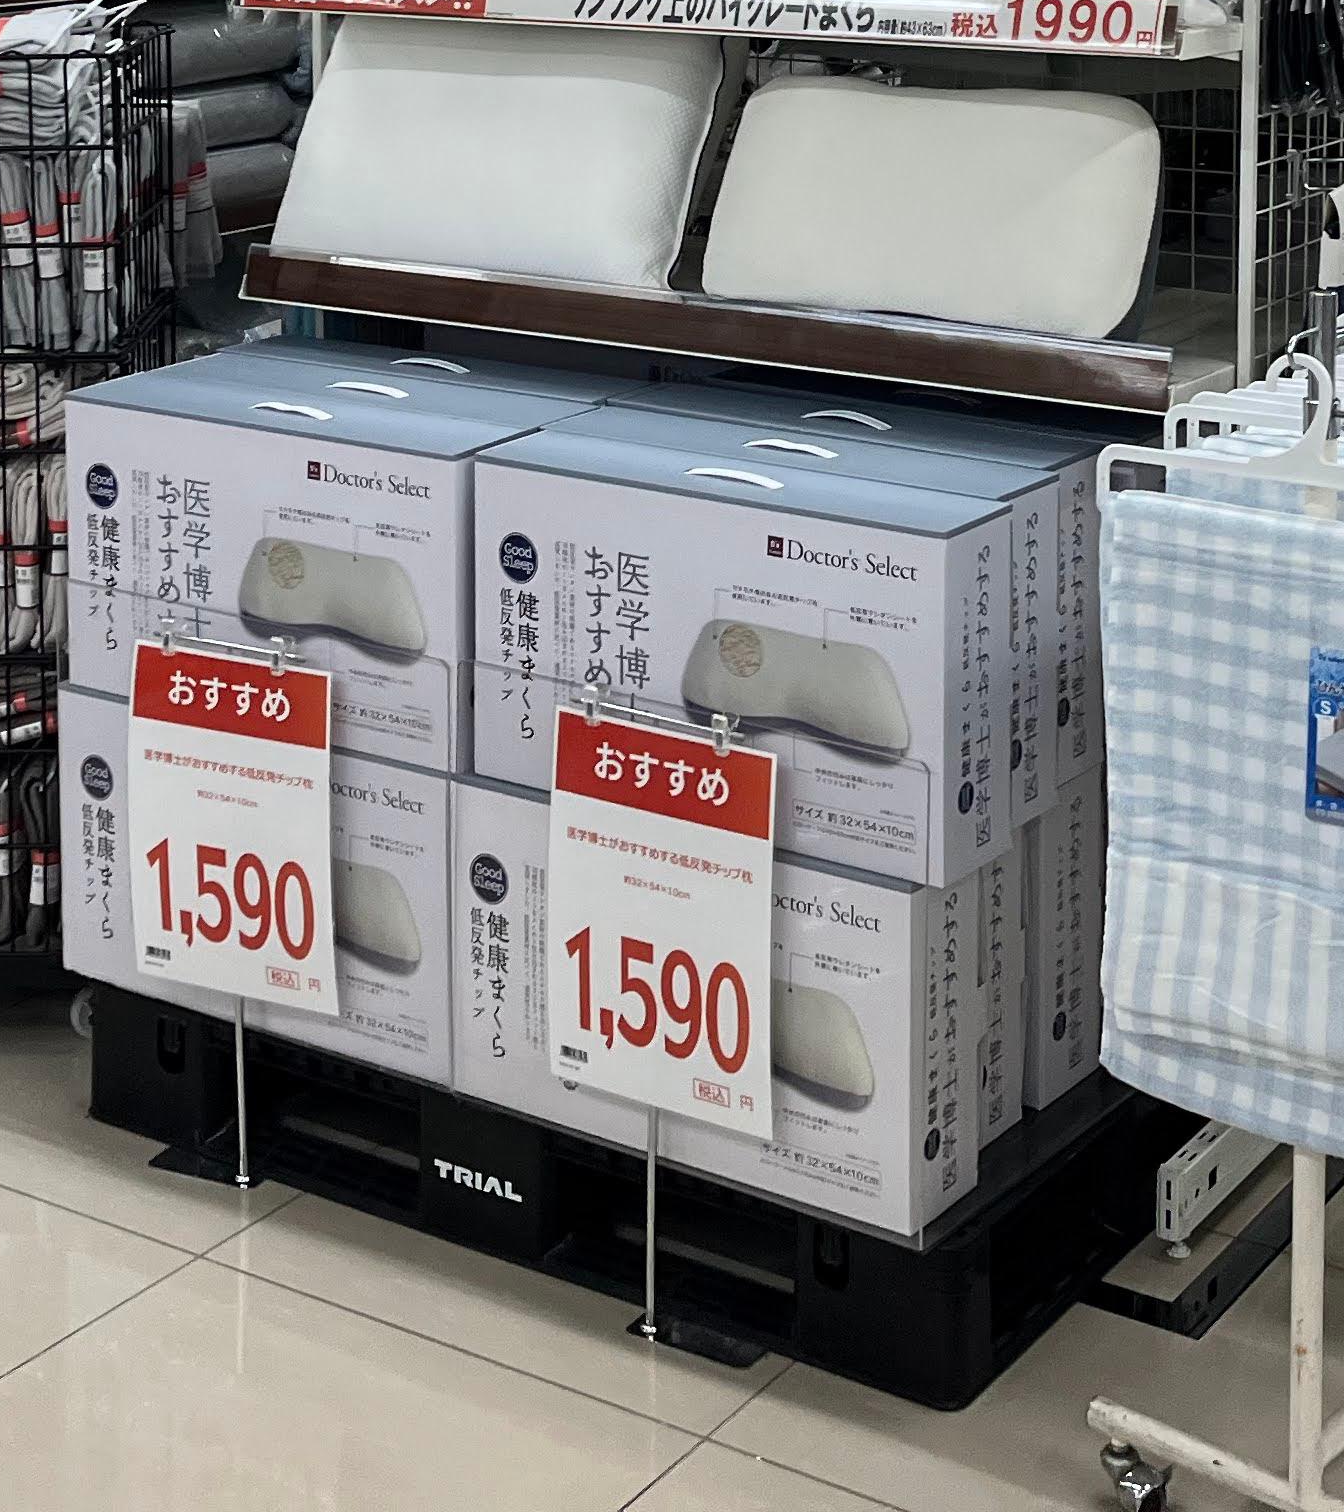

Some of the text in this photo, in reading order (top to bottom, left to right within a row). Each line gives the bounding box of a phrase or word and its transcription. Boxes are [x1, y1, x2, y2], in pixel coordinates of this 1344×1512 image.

[951, 12, 998, 39] 税込
[323, 463, 432, 499] Doctor's Select
[87, 513, 100, 617] 低反発チップ
[503, 556, 534, 575] Sleep
[504, 543, 533, 559] Good
[787, 539, 918, 582] Doctor's Select
[100, 515, 121, 650] 健康まくら
[500, 588, 515, 701] 低反発チップ
[516, 590, 540, 738] 健康まくら
[167, 671, 293, 722] おすすめ
[1320, 700, 1332, 714] S
[594, 742, 730, 807] おすすめ
[331, 782, 425, 817] octor's Select
[795, 805, 824, 820] サイズ
[81, 803, 97, 906] 低反発チップ
[96, 807, 116, 940] 健康まくら
[475, 863, 503, 881] Good
[146, 837, 315, 961] 1,590
[831, 902, 882, 933] Select
[470, 907, 485, 1019] 低反発チップ
[487, 911, 510, 1058] 健康まくら
[565, 926, 751, 1075] 1,590
[740, 1095, 754, 1111] 円
[434, 1158, 524, 1203] TRIAL
